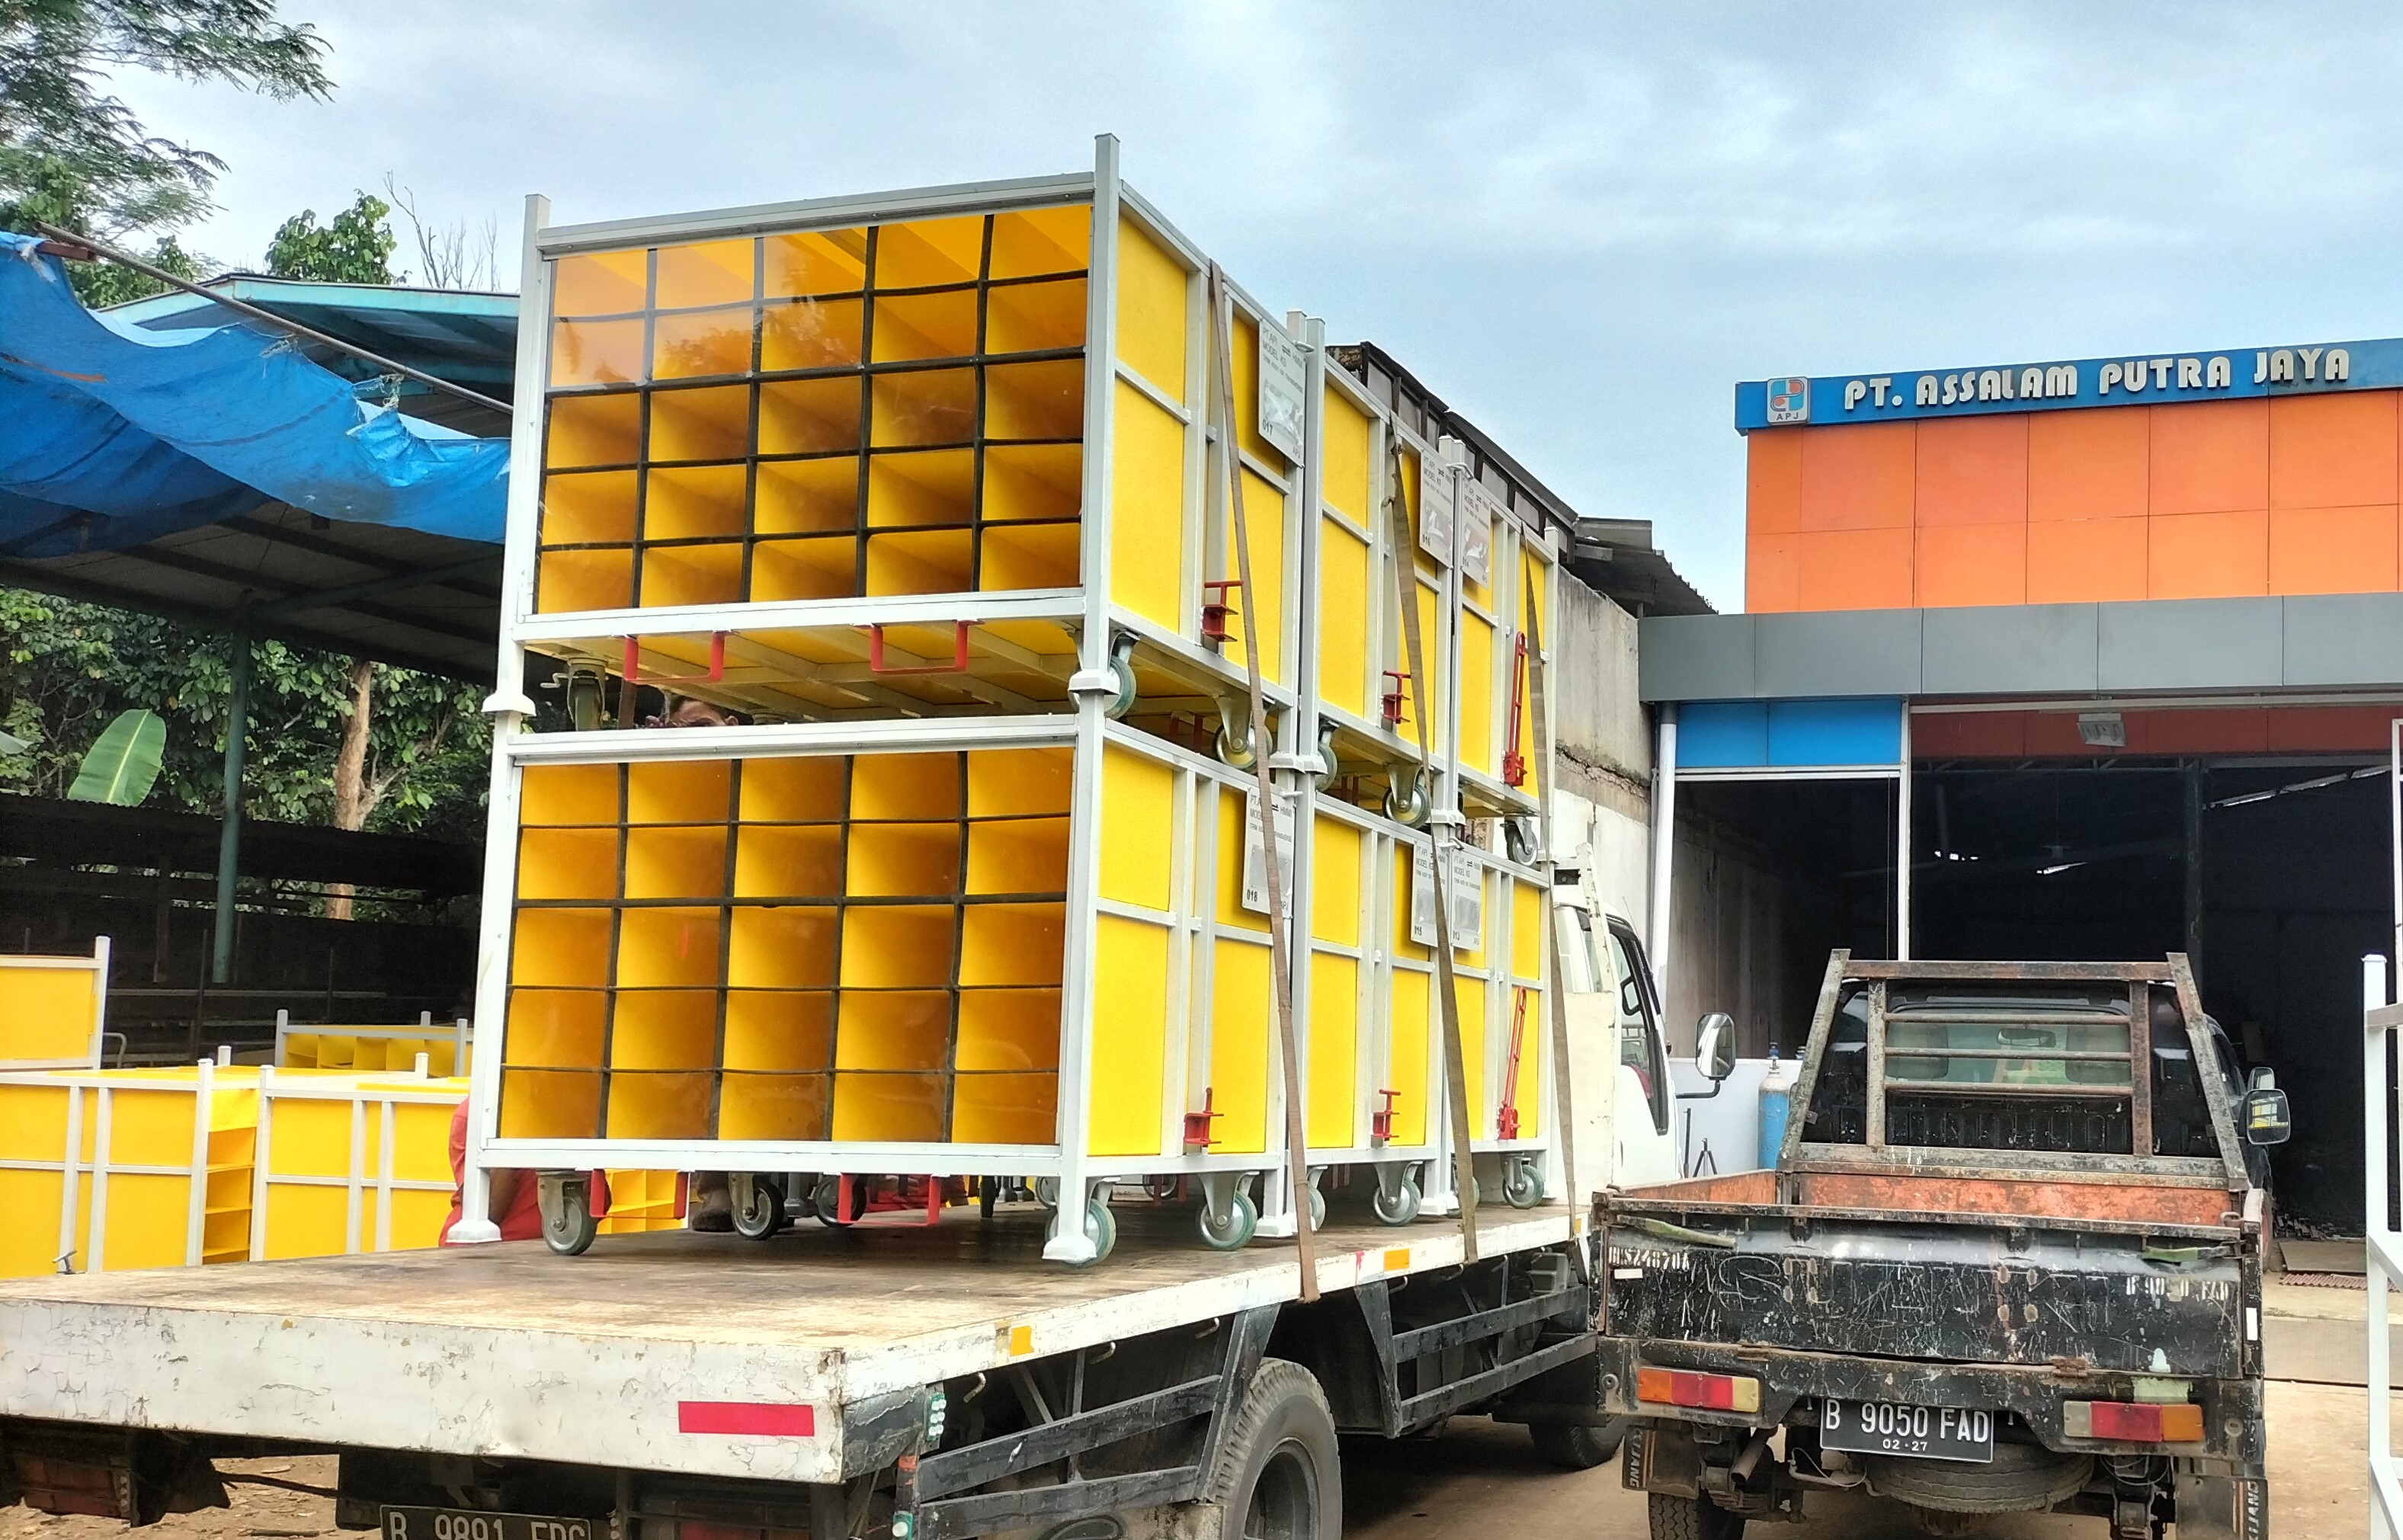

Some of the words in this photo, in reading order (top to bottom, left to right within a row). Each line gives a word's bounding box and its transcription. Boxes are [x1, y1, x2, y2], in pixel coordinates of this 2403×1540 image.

[1262, 339, 1279, 360] MODEL
[1844, 377, 1903, 410] PT.
[1916, 364, 2078, 405] ASSALAM
[2099, 356, 2231, 395] PUTRA
[2254, 347, 2350, 384] JAYA
[1777, 412, 1799, 421] APJ
[1262, 418, 1274, 436] 017
[1247, 888, 1258, 902] 018
[1825, 1399, 1841, 1430] B
[1861, 1402, 1928, 1438] 9050
[1940, 1409, 1988, 1442] FAD
